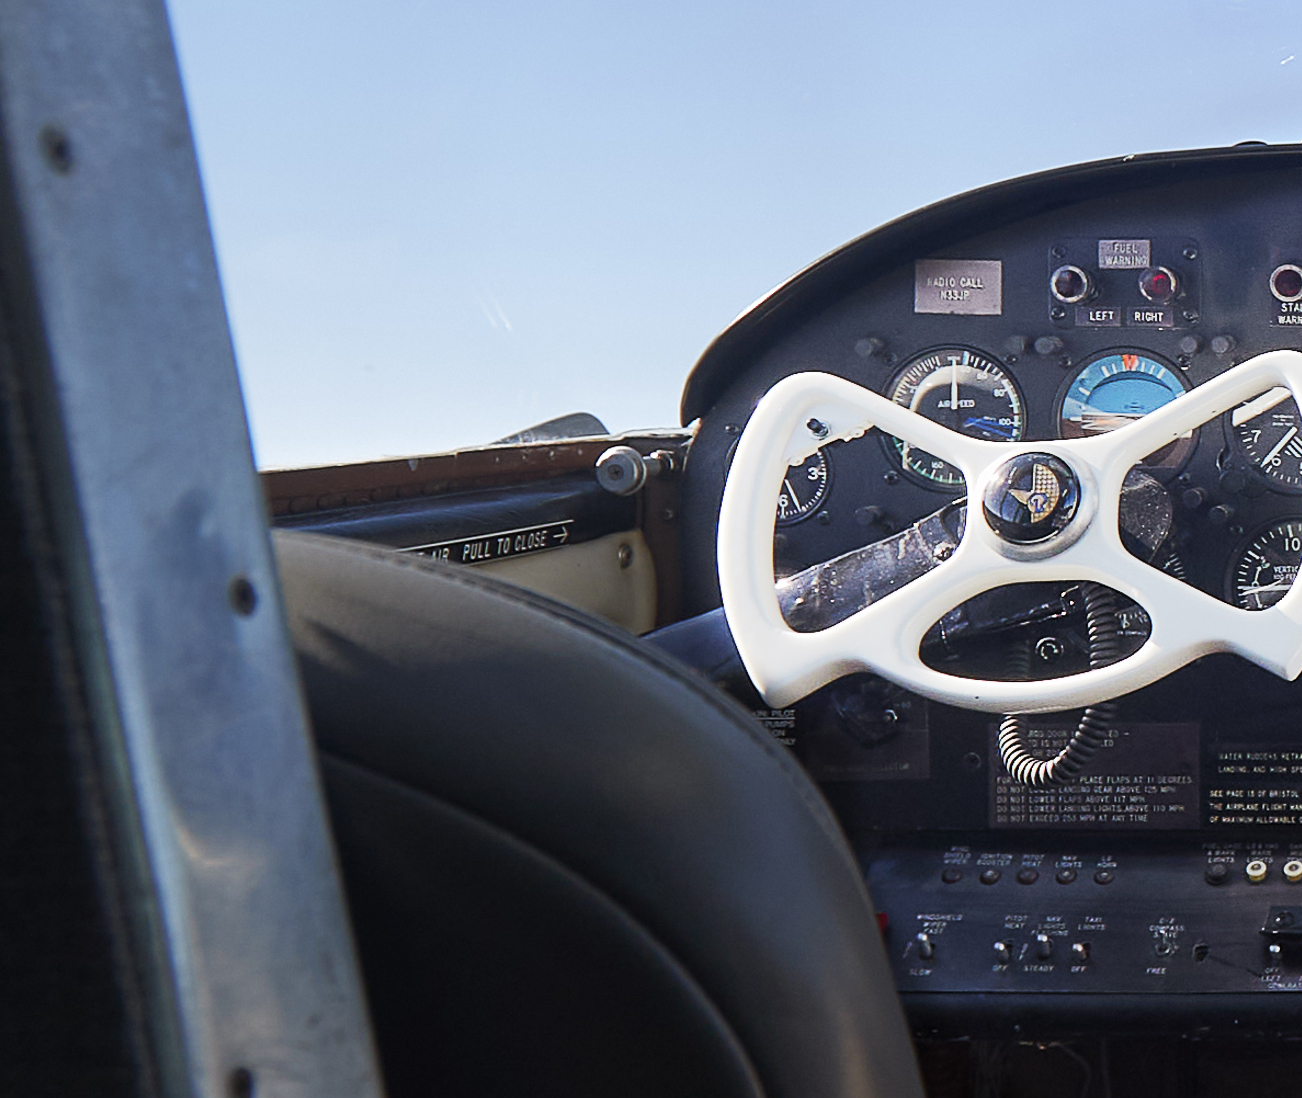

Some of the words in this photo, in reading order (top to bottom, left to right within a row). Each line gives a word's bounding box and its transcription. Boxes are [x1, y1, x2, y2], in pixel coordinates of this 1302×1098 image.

[1113, 243, 1137, 254] FUEL
[1105, 255, 1148, 266] WARNING
[960, 278, 983, 289] CALL
[1090, 311, 1114, 322] LEFT
[1134, 311, 1163, 322] RIGHT
[1251, 430, 1261, 443] 7
[808, 467, 818, 480] 3
[463, 544, 491, 561] PULL
[497, 538, 510, 555] TO
[514, 531, 547, 551] CLOSE
[1285, 538, 1300, 550] 10
